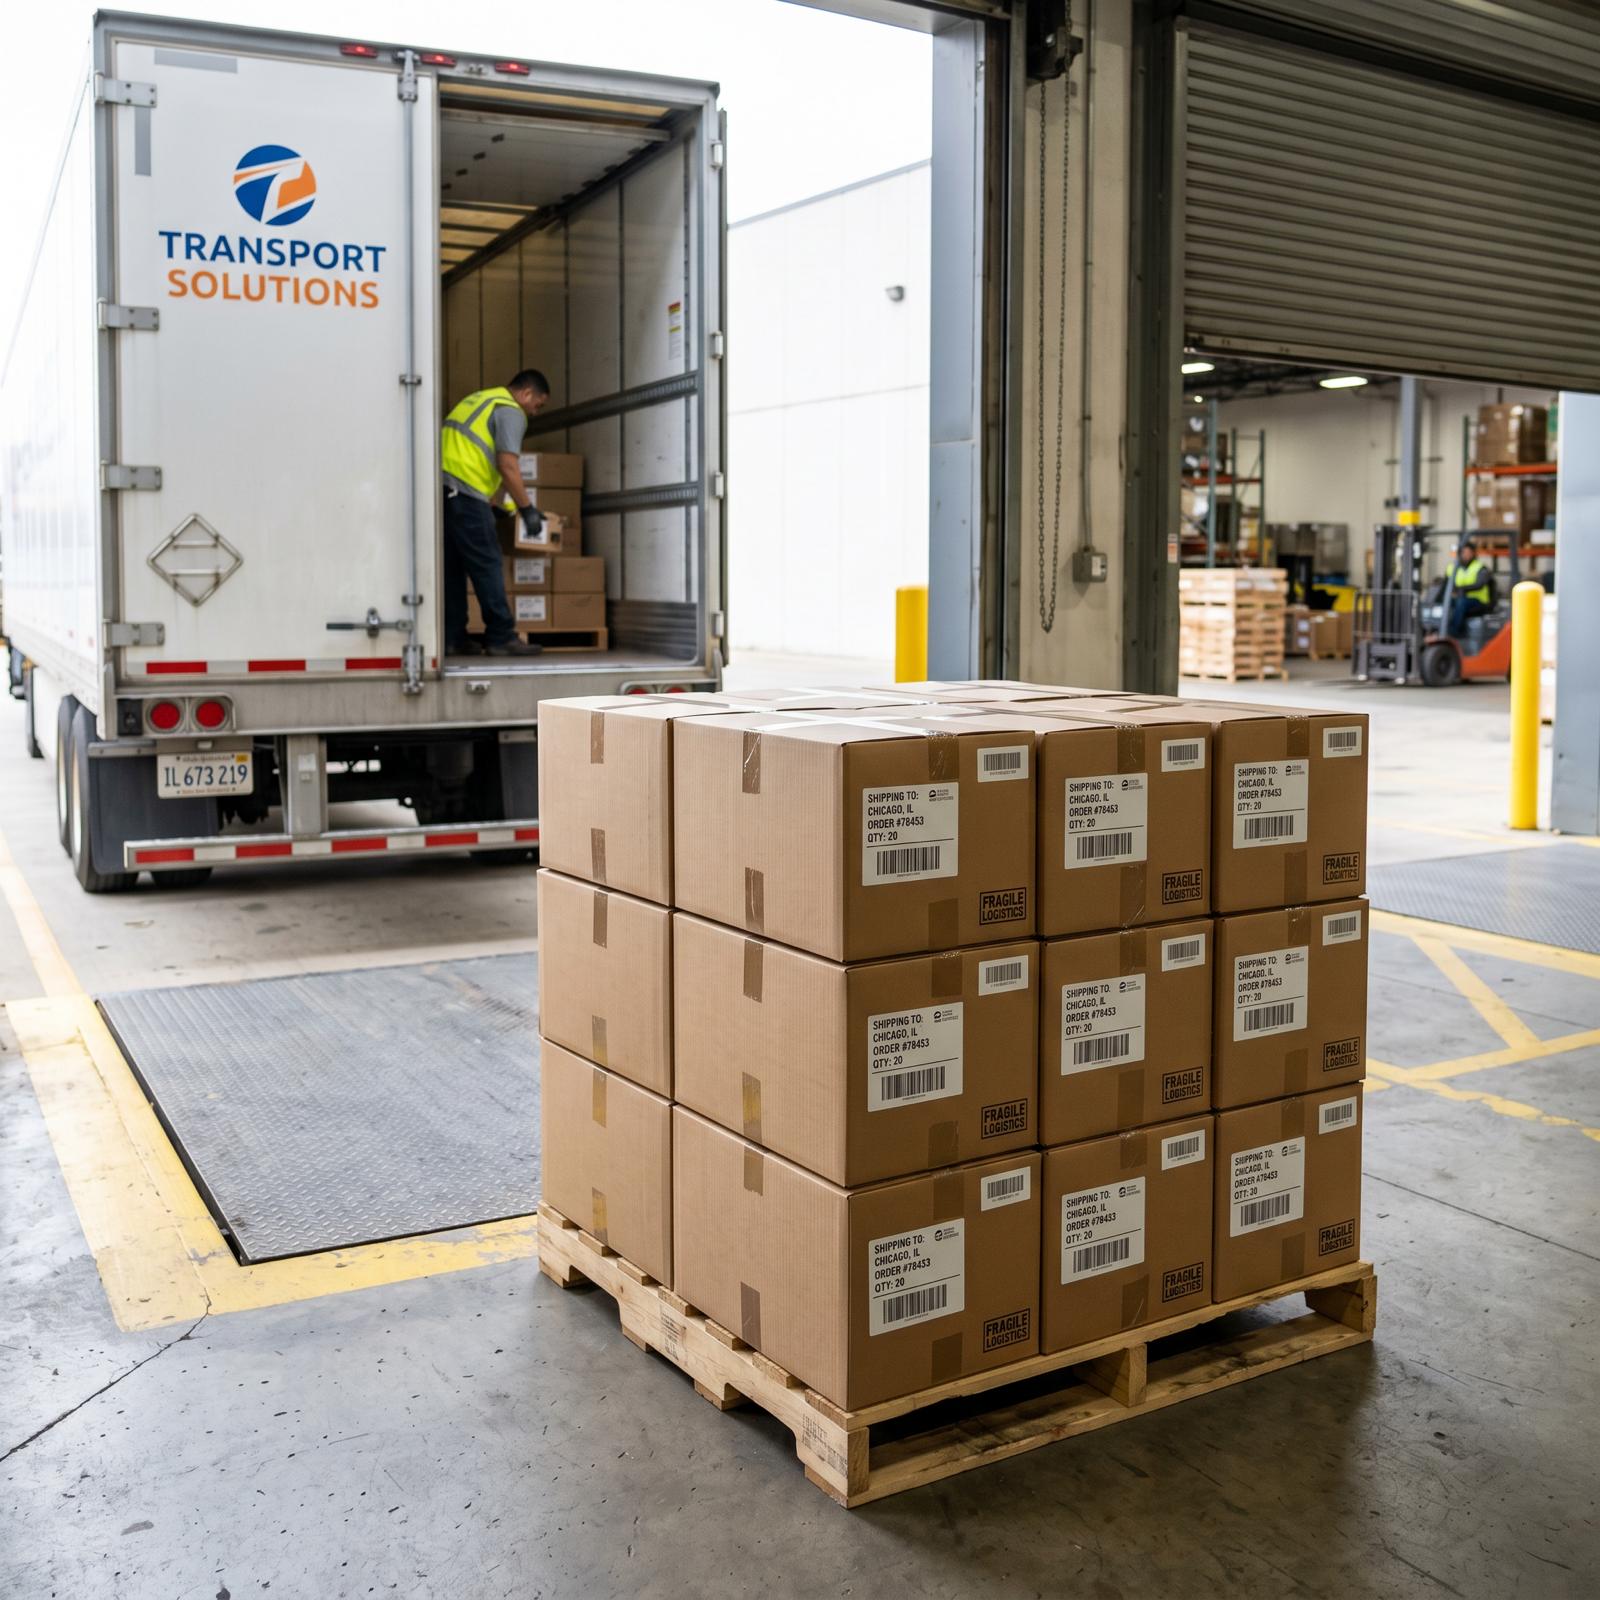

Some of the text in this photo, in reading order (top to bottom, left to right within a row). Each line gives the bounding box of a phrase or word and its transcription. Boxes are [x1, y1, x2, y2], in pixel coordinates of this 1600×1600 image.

[159, 231, 386, 272] TRANSPORT
[168, 269, 379, 309] SOLUTIONS
[165, 764, 248, 787] IL 673 219
[1238, 767, 1266, 776] SHIPPING
[1070, 782, 1101, 792] SHIPPING
[1104, 781, 1114, 789] TO:
[868, 792, 904, 803] SHIPPING
[907, 791, 919, 800] TO:
[1103, 793, 1109, 801] IL
[1238, 788, 1282, 800] ORDER #78453
[868, 804, 914, 816] CHICAGO, IL
[1069, 804, 1118, 816] ORDER #78453
[868, 816, 924, 830] ORDER #78453
[1069, 819, 1095, 829] QTY: 20
[868, 831, 898, 843] QTY: 20
[1326, 856, 1357, 870] FRAGILE
[1165, 873, 1200, 889] FRAGILE
[983, 892, 1023, 909] FRAGILE
[1165, 887, 1200, 901] LOGISTICS
[982, 906, 1024, 921] LOGISTICS
[1238, 958, 1266, 970] SHIPPING
[1067, 986, 1098, 998] SHIPPING
[1238, 982, 1259, 992] ORDER
[873, 1016, 909, 1030] SHIPPING
[911, 1014, 923, 1024] TO:
[1066, 1007, 1116, 1023] ORDER #78453
[911, 1028, 917, 1036] IL
[1084, 1023, 1092, 1032] 20
[873, 1038, 929, 1055] ORDER #78453
[1326, 1040, 1358, 1057] FRAGILE
[894, 1056, 903, 1065] 20
[1326, 1053, 1357, 1068] LOGISTICS
[1165, 1071, 1201, 1089] FRAGILE
[1165, 1084, 1200, 1100] LOGISTICS
[984, 1103, 1025, 1123] FRAGILE
[984, 1117, 1024, 1135] LOGISTICS
[1235, 1152, 1262, 1166] SHIPPING
[1235, 1177, 1255, 1188] ORDER
[1066, 1193, 1098, 1208] SHIPPING
[1100, 1203, 1106, 1211] IL
[1066, 1219, 1089, 1232] ORDER
[1322, 1223, 1352, 1242] FRAGILE
[1084, 1230, 1092, 1240] 20
[874, 1235, 924, 1254] SHIPPING TO:
[875, 1248, 920, 1267] CHICAGO, IL
[875, 1258, 930, 1279] ORDER #78453
[895, 1278, 904, 1288] 20
[1165, 1267, 1201, 1288] FRAGILE
[986, 1313, 1027, 1336] FRAGILE
[986, 1327, 1027, 1348] LOGISTICS
